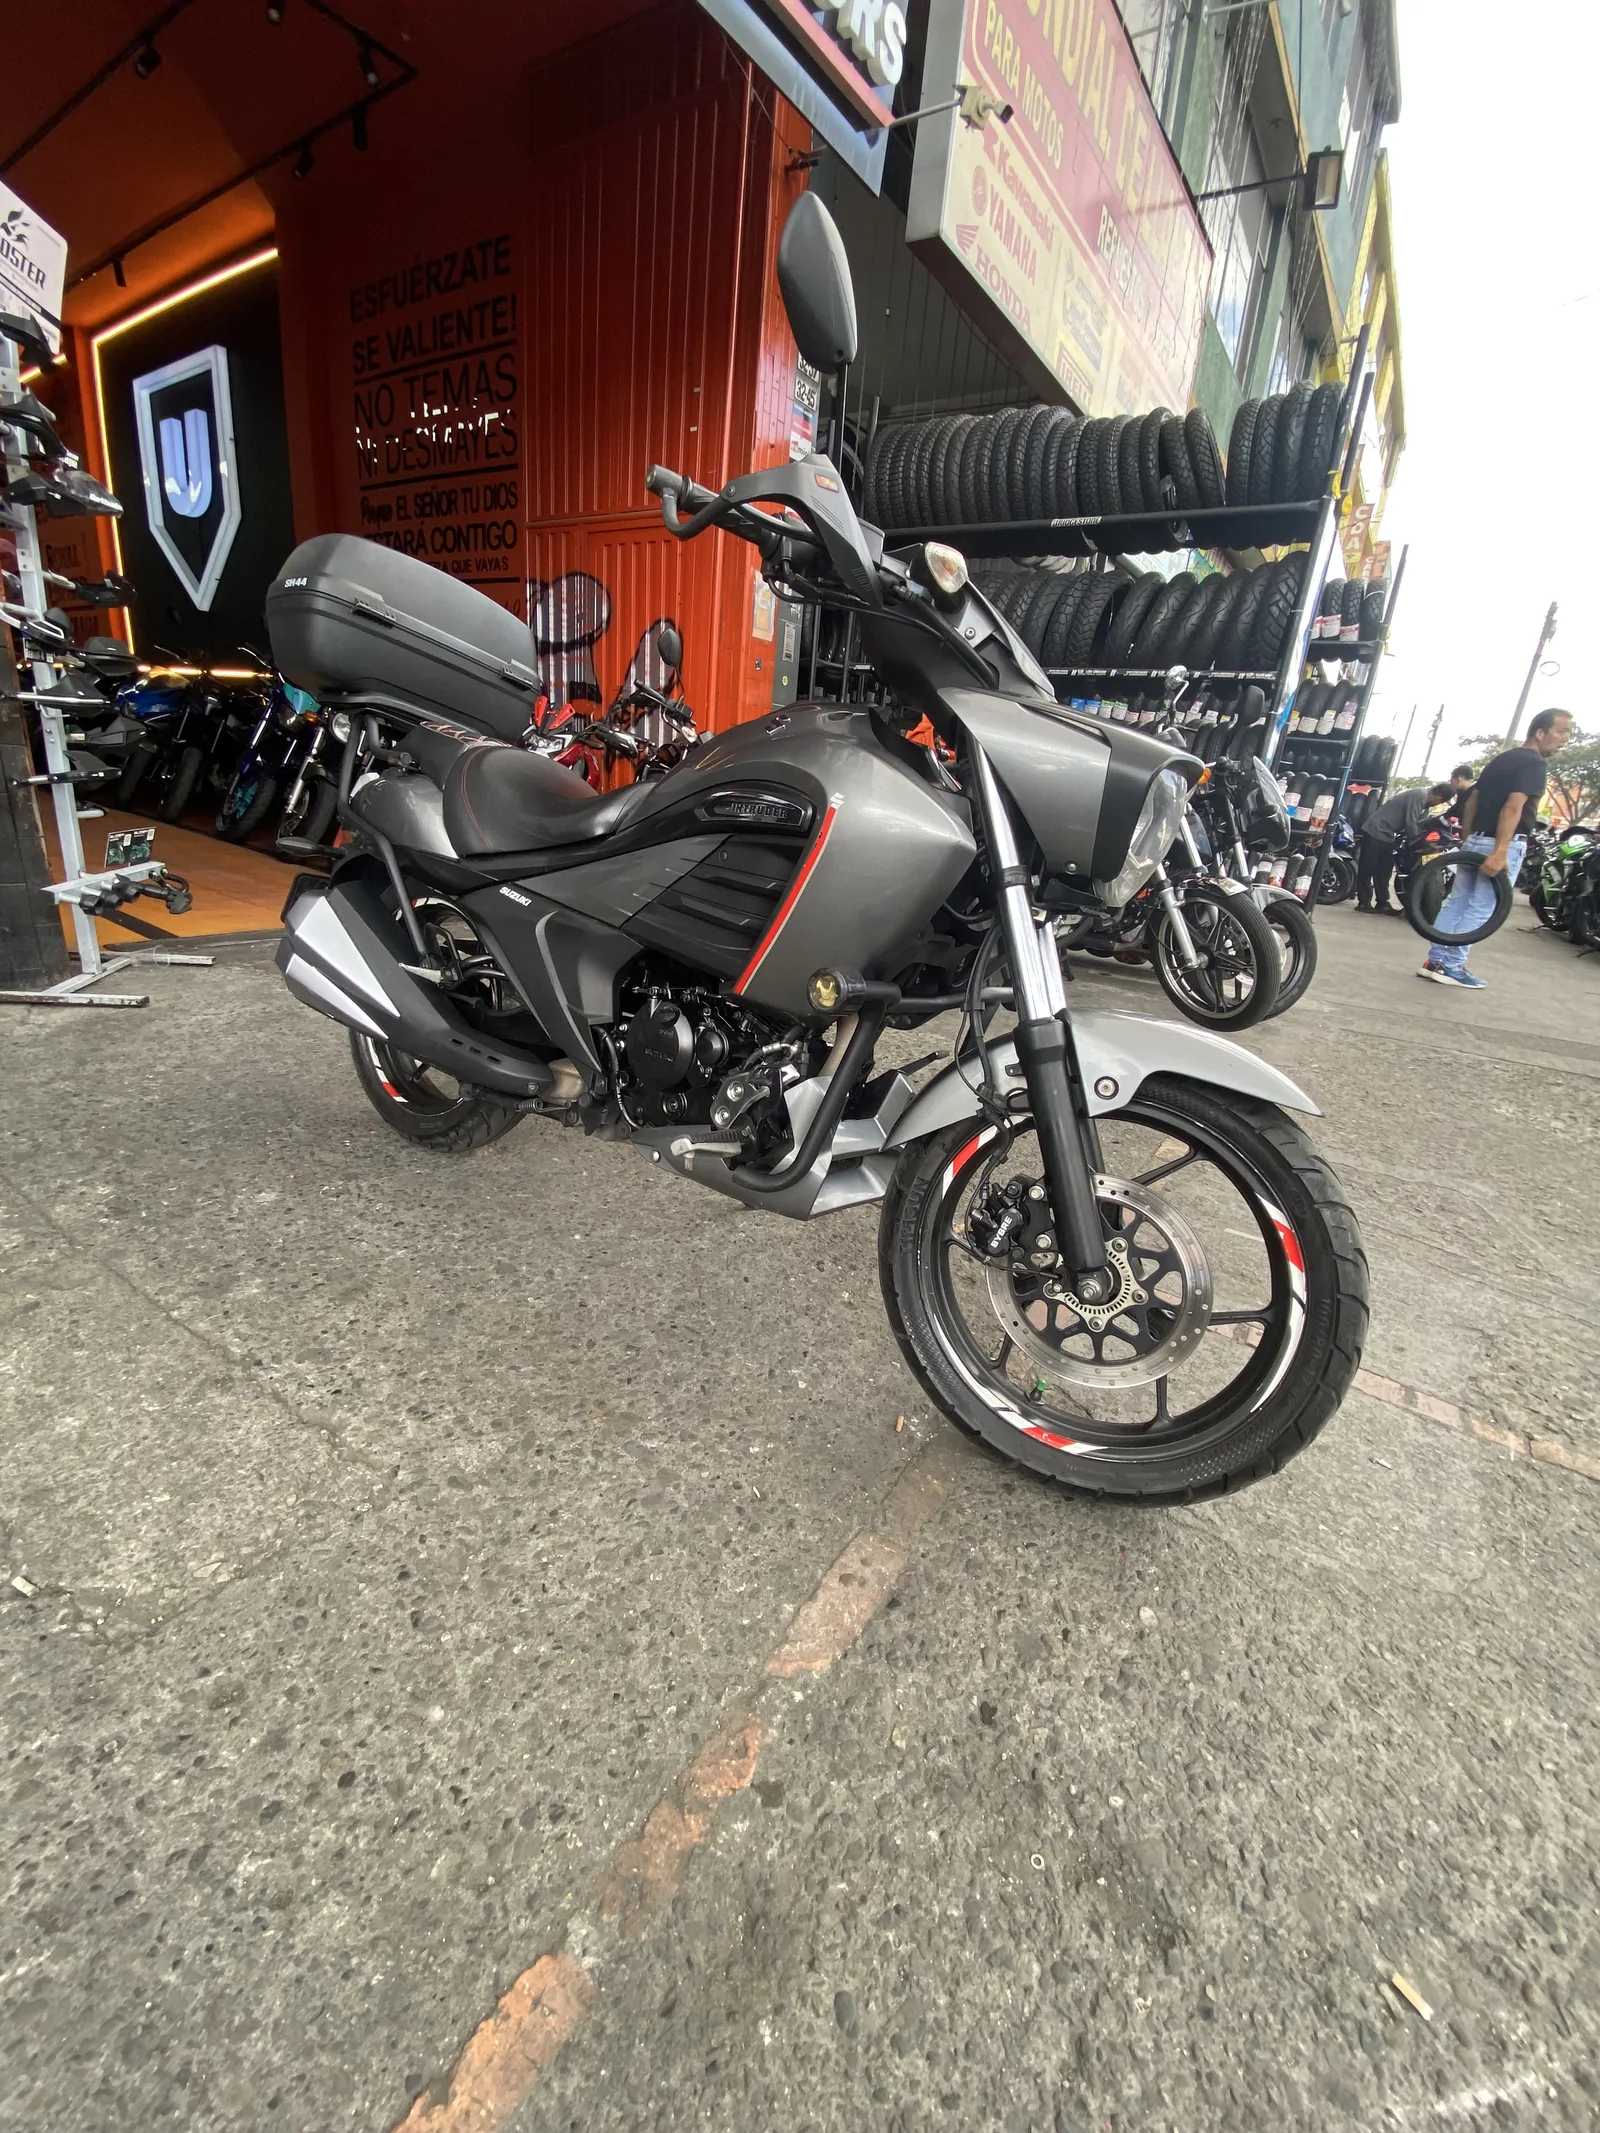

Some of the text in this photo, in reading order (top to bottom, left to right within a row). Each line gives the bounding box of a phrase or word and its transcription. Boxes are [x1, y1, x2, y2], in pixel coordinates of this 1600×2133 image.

[984, 0, 1064, 171] PARA MOTOS
[998, 137, 1054, 250] Kawasaki
[988, 184, 1037, 285] YAMAHA
[350, 233, 511, 324] ESFUÉRZATE
[975, 245, 1032, 336] HONDA
[353, 293, 518, 375] SE VALIENTE!
[354, 352, 517, 432] NO TEMAS
[386, 410, 518, 474] DESMAYES
[395, 495, 412, 521] EL
[414, 484, 458, 519] SEÑOR
[461, 487, 480, 514] TU
[483, 481, 518, 513] DIOS
[430, 519, 518, 554] CONTIGO
[451, 559, 472, 574] QUE
[474, 556, 509, 572] VAYAS
[284, 577, 308, 588] SH44
[730, 803, 788, 819] INTRUDER
[499, 886, 533, 907] SUZUKI
[990, 1215, 1013, 1248] BYBRE
